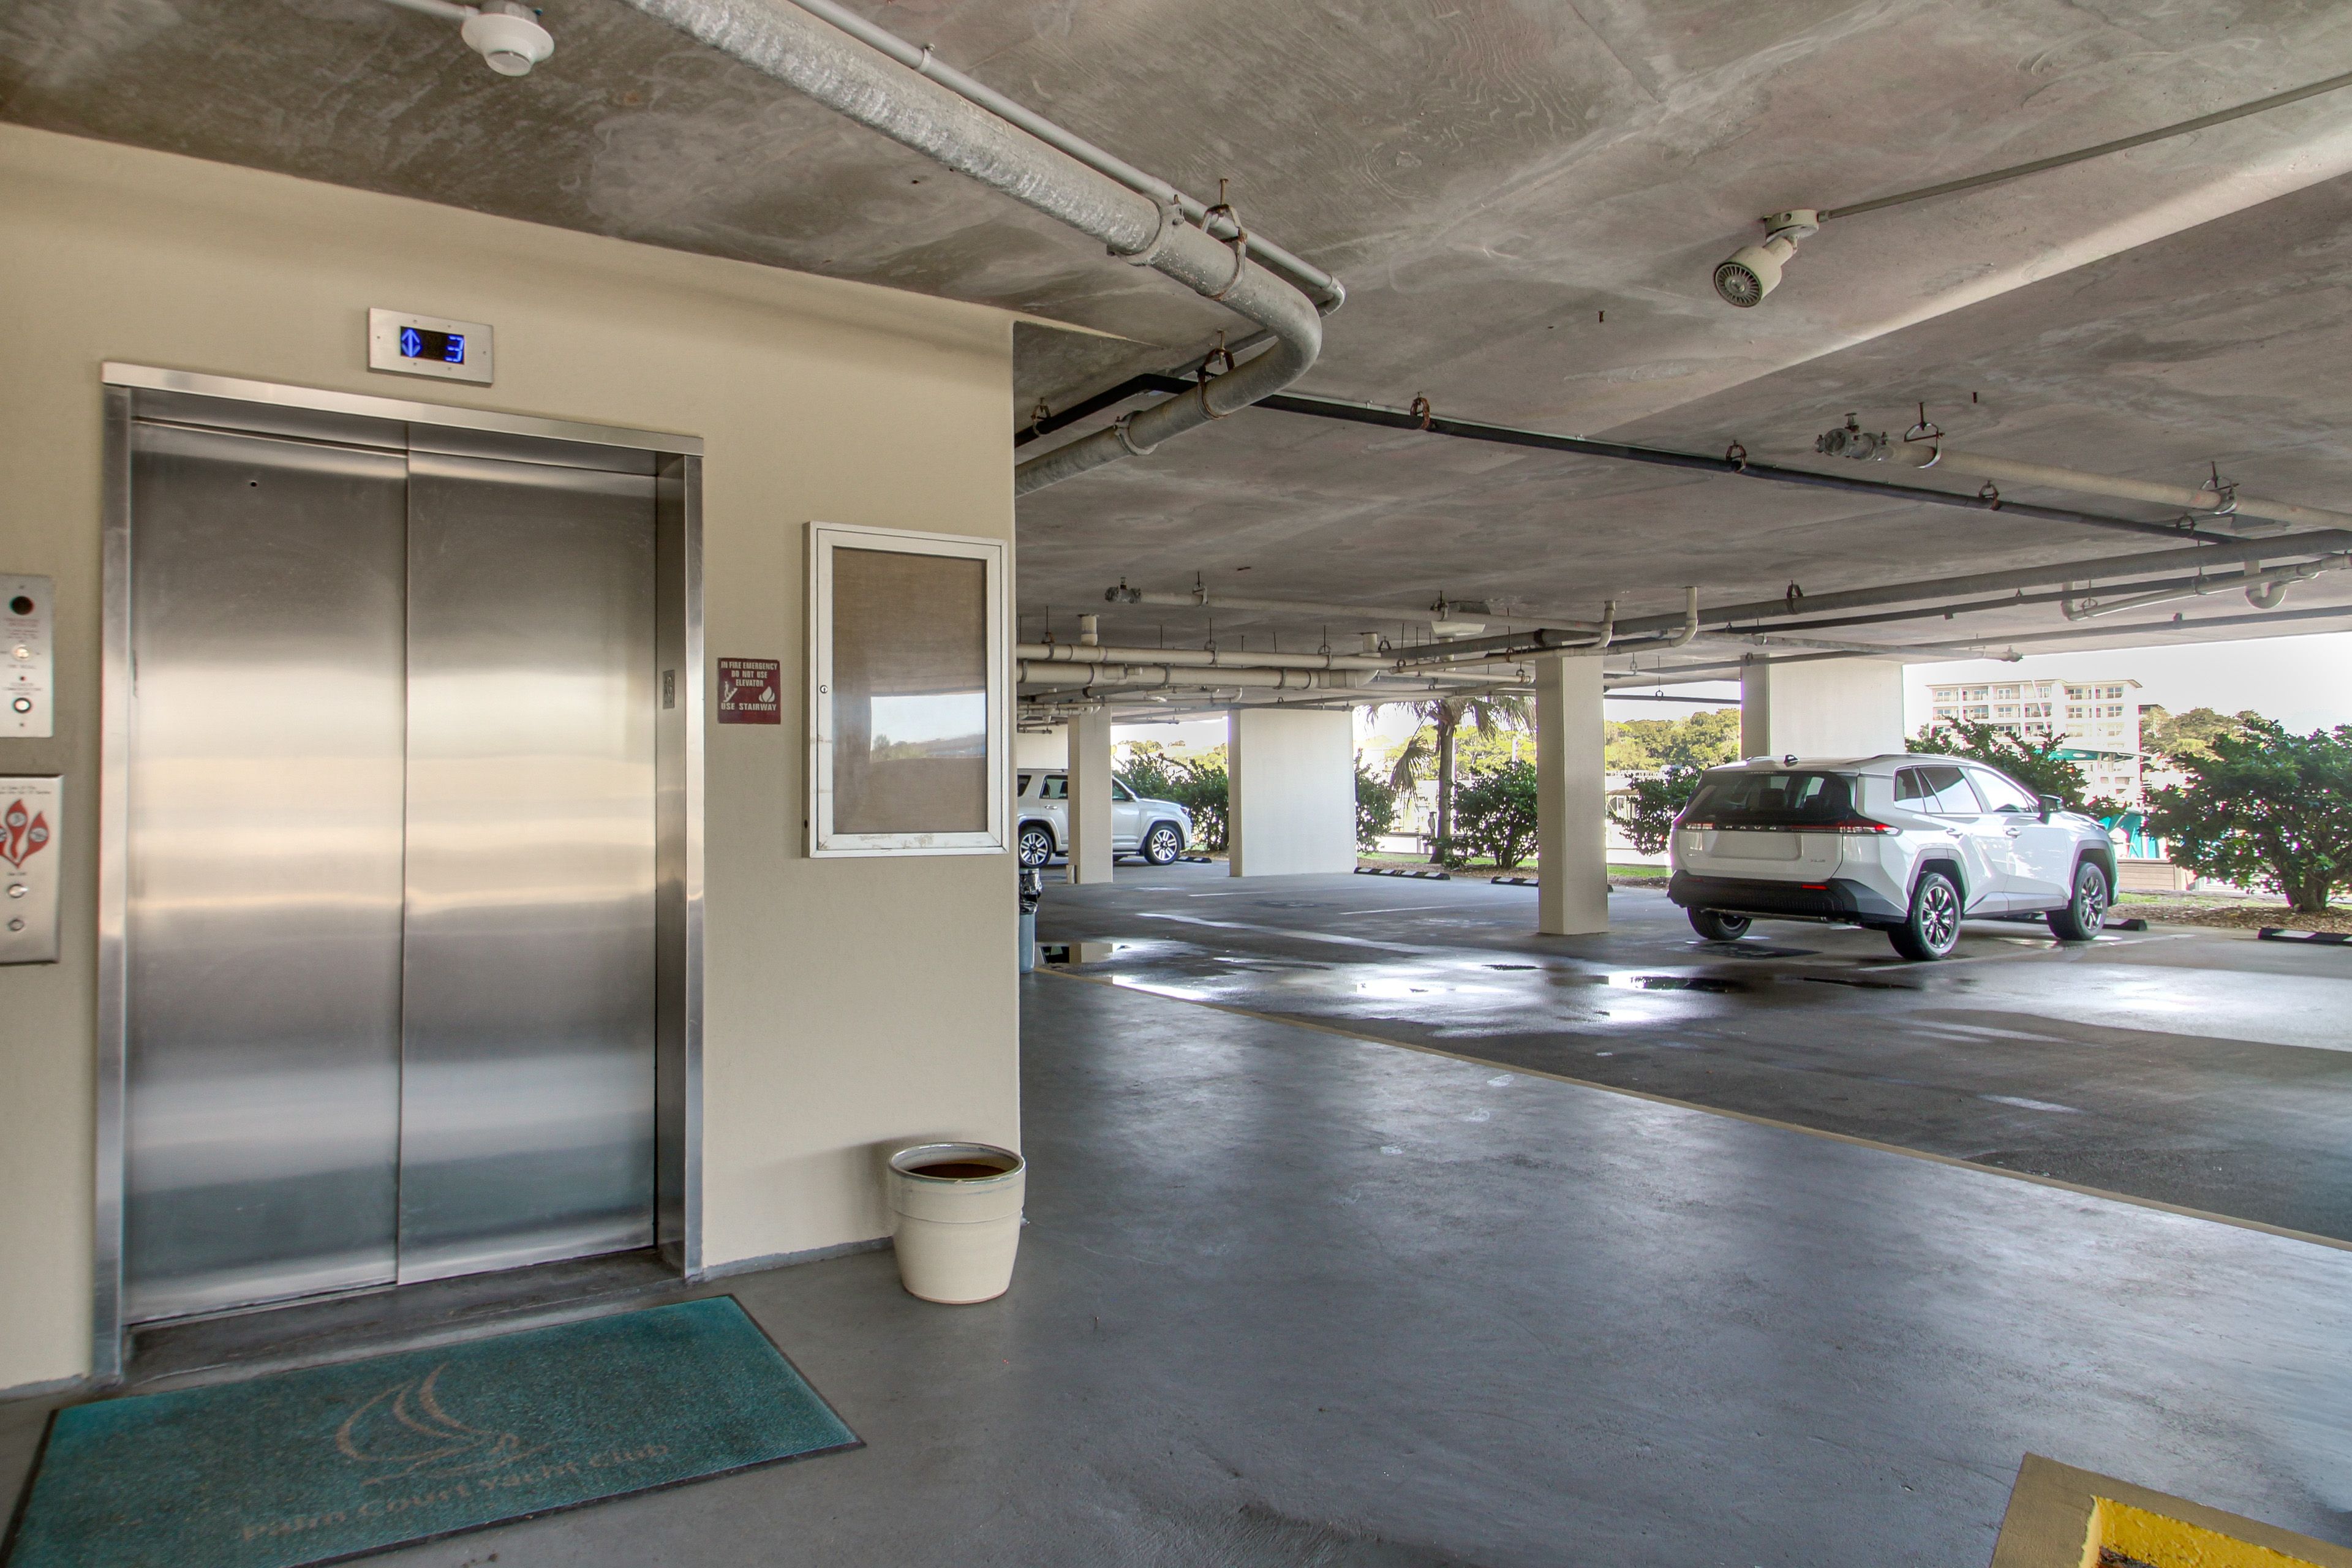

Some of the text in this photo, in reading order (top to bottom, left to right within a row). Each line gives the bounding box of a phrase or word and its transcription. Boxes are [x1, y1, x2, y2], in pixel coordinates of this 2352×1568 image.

[445, 335, 464, 363] 3
[729, 661, 742, 669] FIRE
[742, 662, 778, 671] EMERGENCY
[739, 703, 777, 711] STAIRWAY
